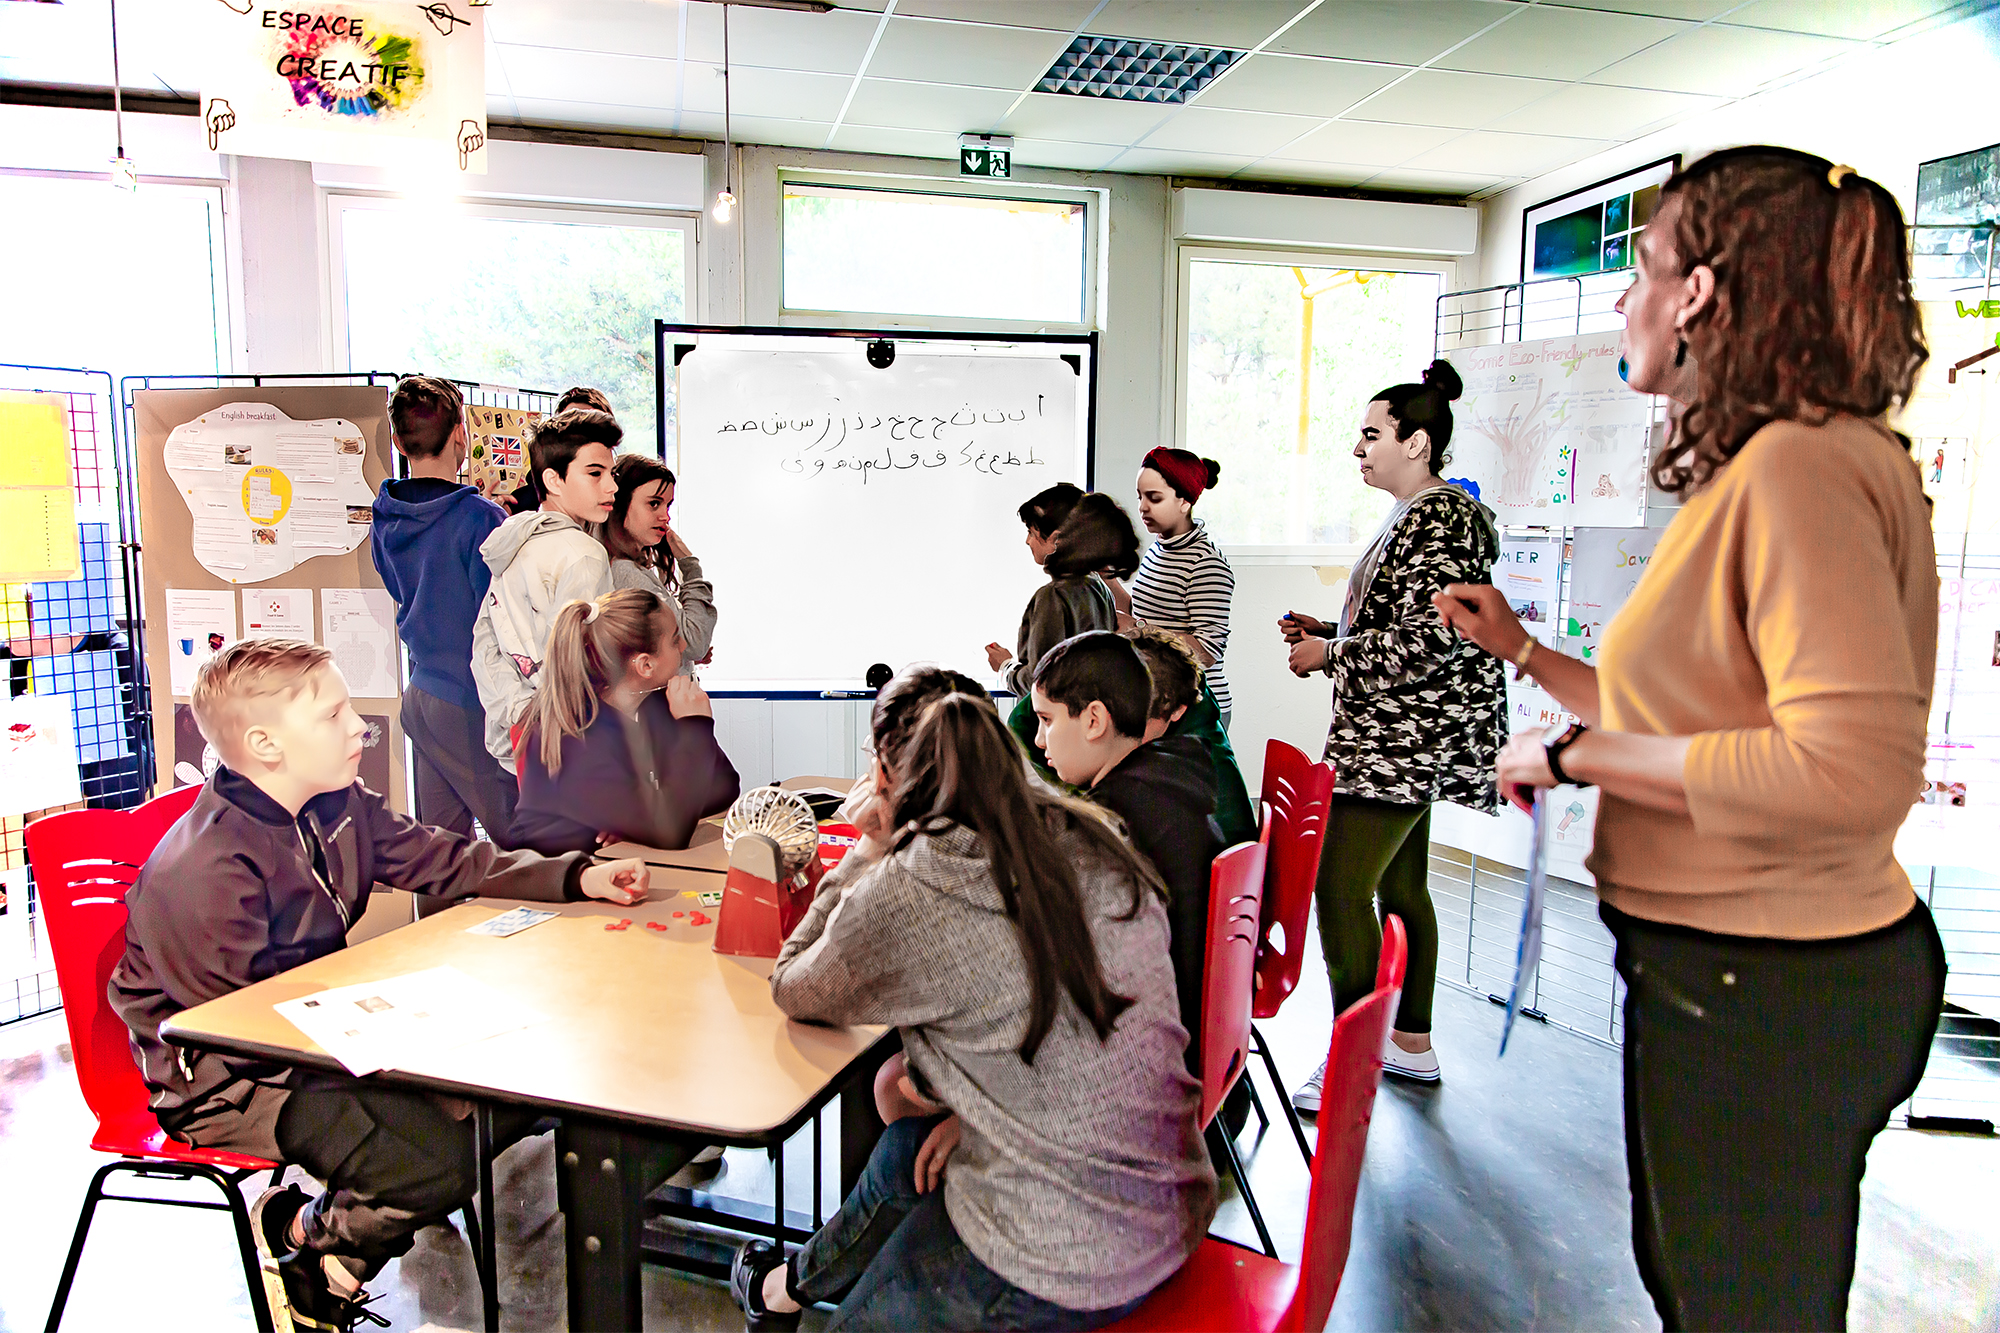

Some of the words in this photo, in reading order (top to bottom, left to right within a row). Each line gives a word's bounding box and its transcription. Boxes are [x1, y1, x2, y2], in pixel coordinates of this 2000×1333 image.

[262, 10, 364, 37] ESPACE
[276, 54, 409, 87] CREATIF
[1466, 347, 1504, 372] Some
[221, 410, 245, 422] English
[246, 410, 277, 421] breakfast
